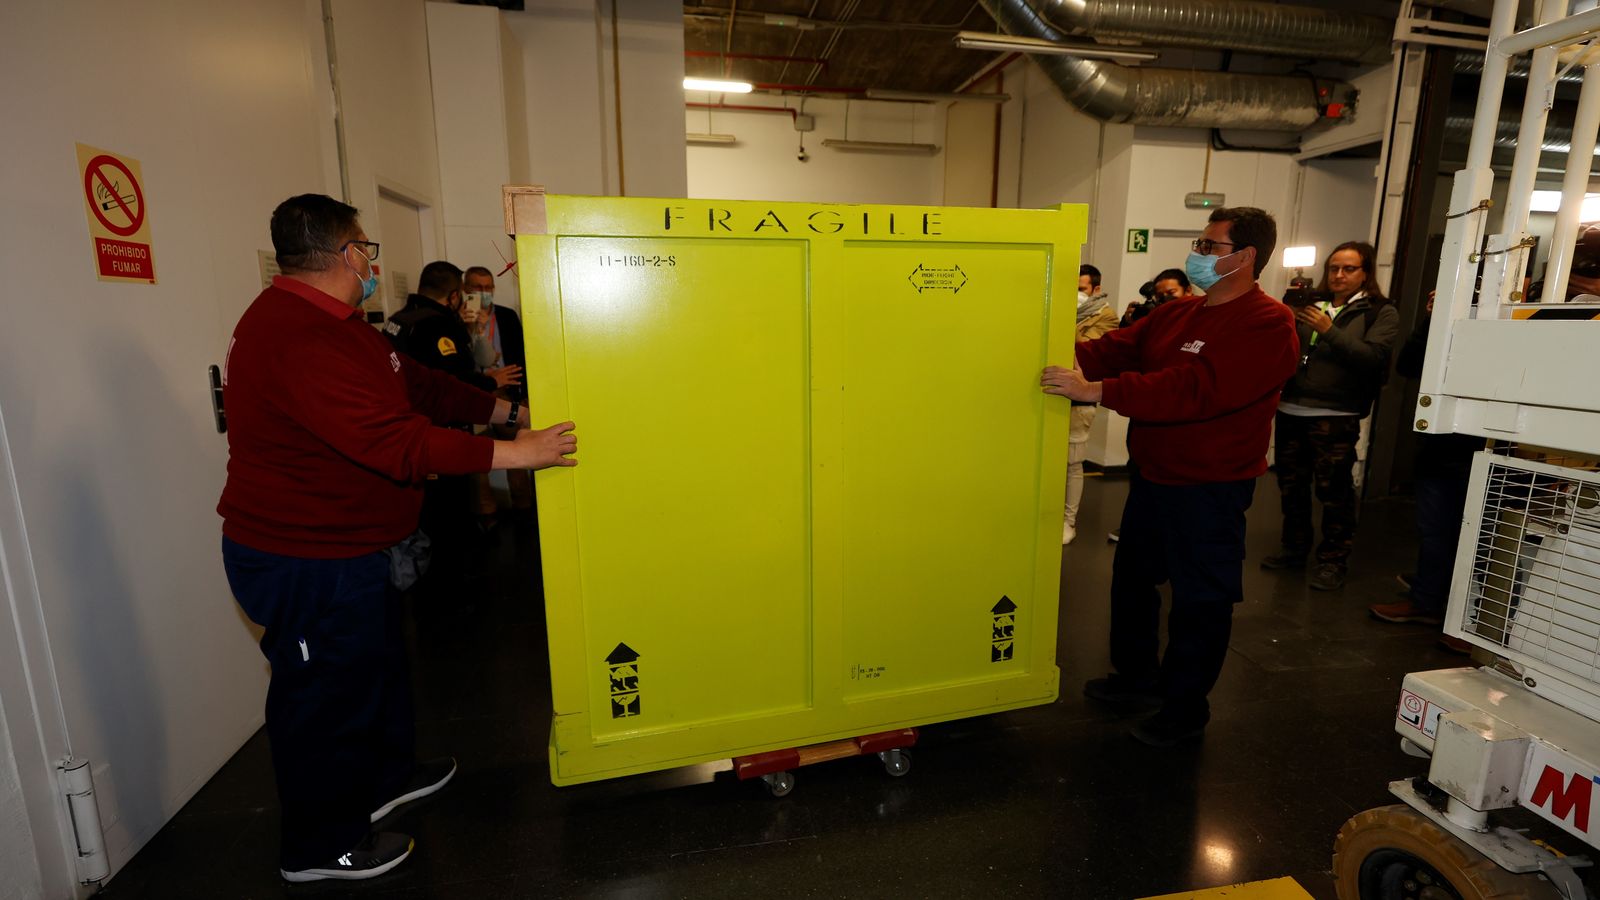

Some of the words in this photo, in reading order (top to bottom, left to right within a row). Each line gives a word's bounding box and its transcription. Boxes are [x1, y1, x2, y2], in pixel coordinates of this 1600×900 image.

[664, 206, 942, 235] FRAGILE
[101, 243, 146, 259] PROHIBIDO
[112, 261, 141, 273] FUMAR
[600, 255, 676, 267] 11-160-2-S
